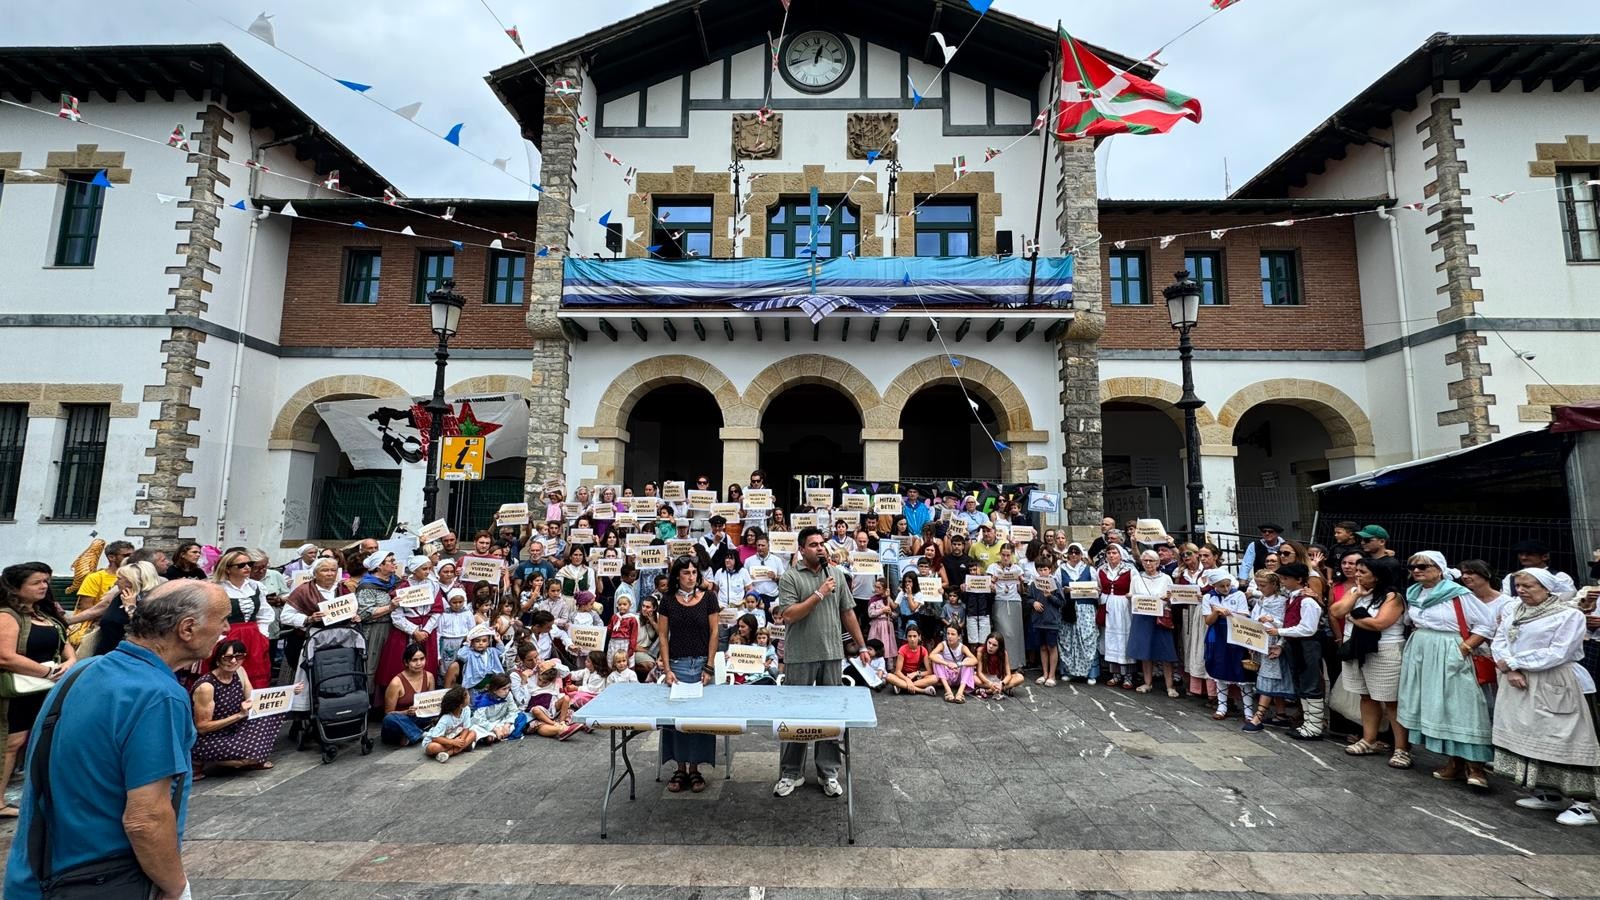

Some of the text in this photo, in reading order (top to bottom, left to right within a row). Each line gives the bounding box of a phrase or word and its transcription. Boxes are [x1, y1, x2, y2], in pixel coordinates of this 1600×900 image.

[327, 599, 350, 610] HITZA
[330, 607, 351, 618] BETE!
[574, 640, 598, 648] PALABRA!
[259, 690, 287, 701] HITZA
[258, 700, 283, 711] BETE!
